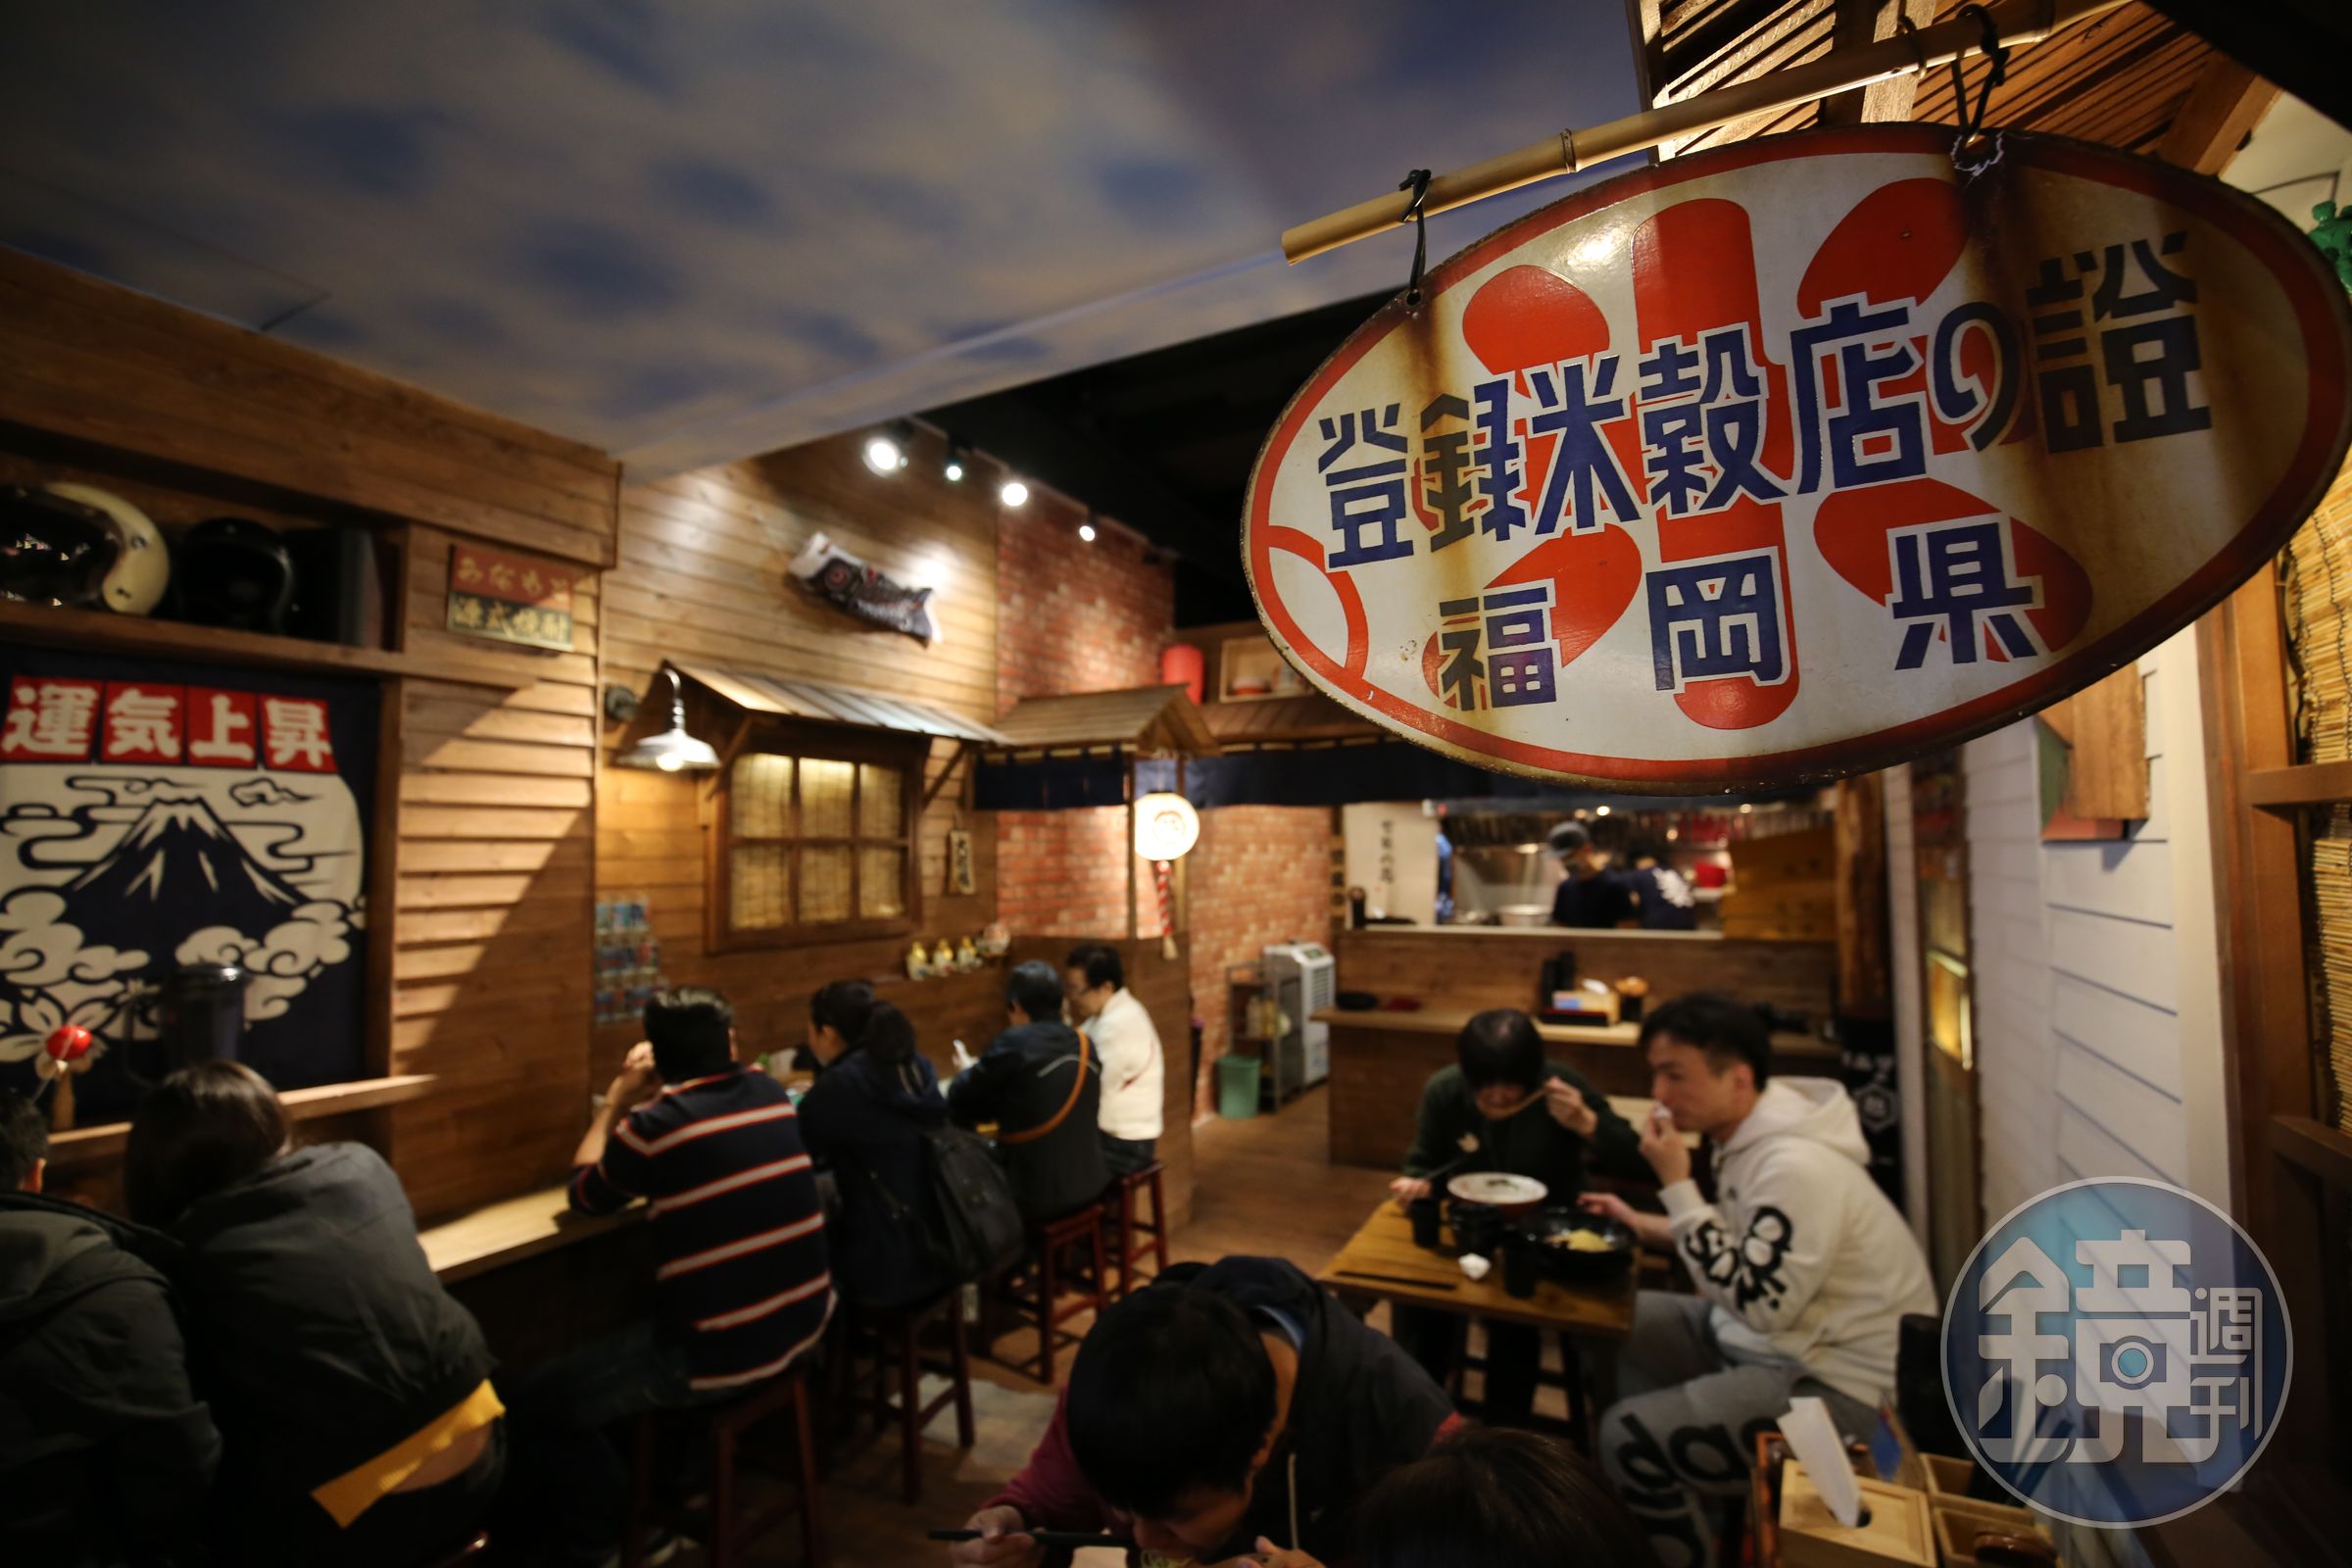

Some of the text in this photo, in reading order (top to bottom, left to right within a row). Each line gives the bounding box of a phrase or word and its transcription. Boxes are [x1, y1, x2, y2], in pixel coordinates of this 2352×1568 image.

[1440, 522, 2038, 711] 福岡県
[1, 684, 333, 767] 運気上昇
